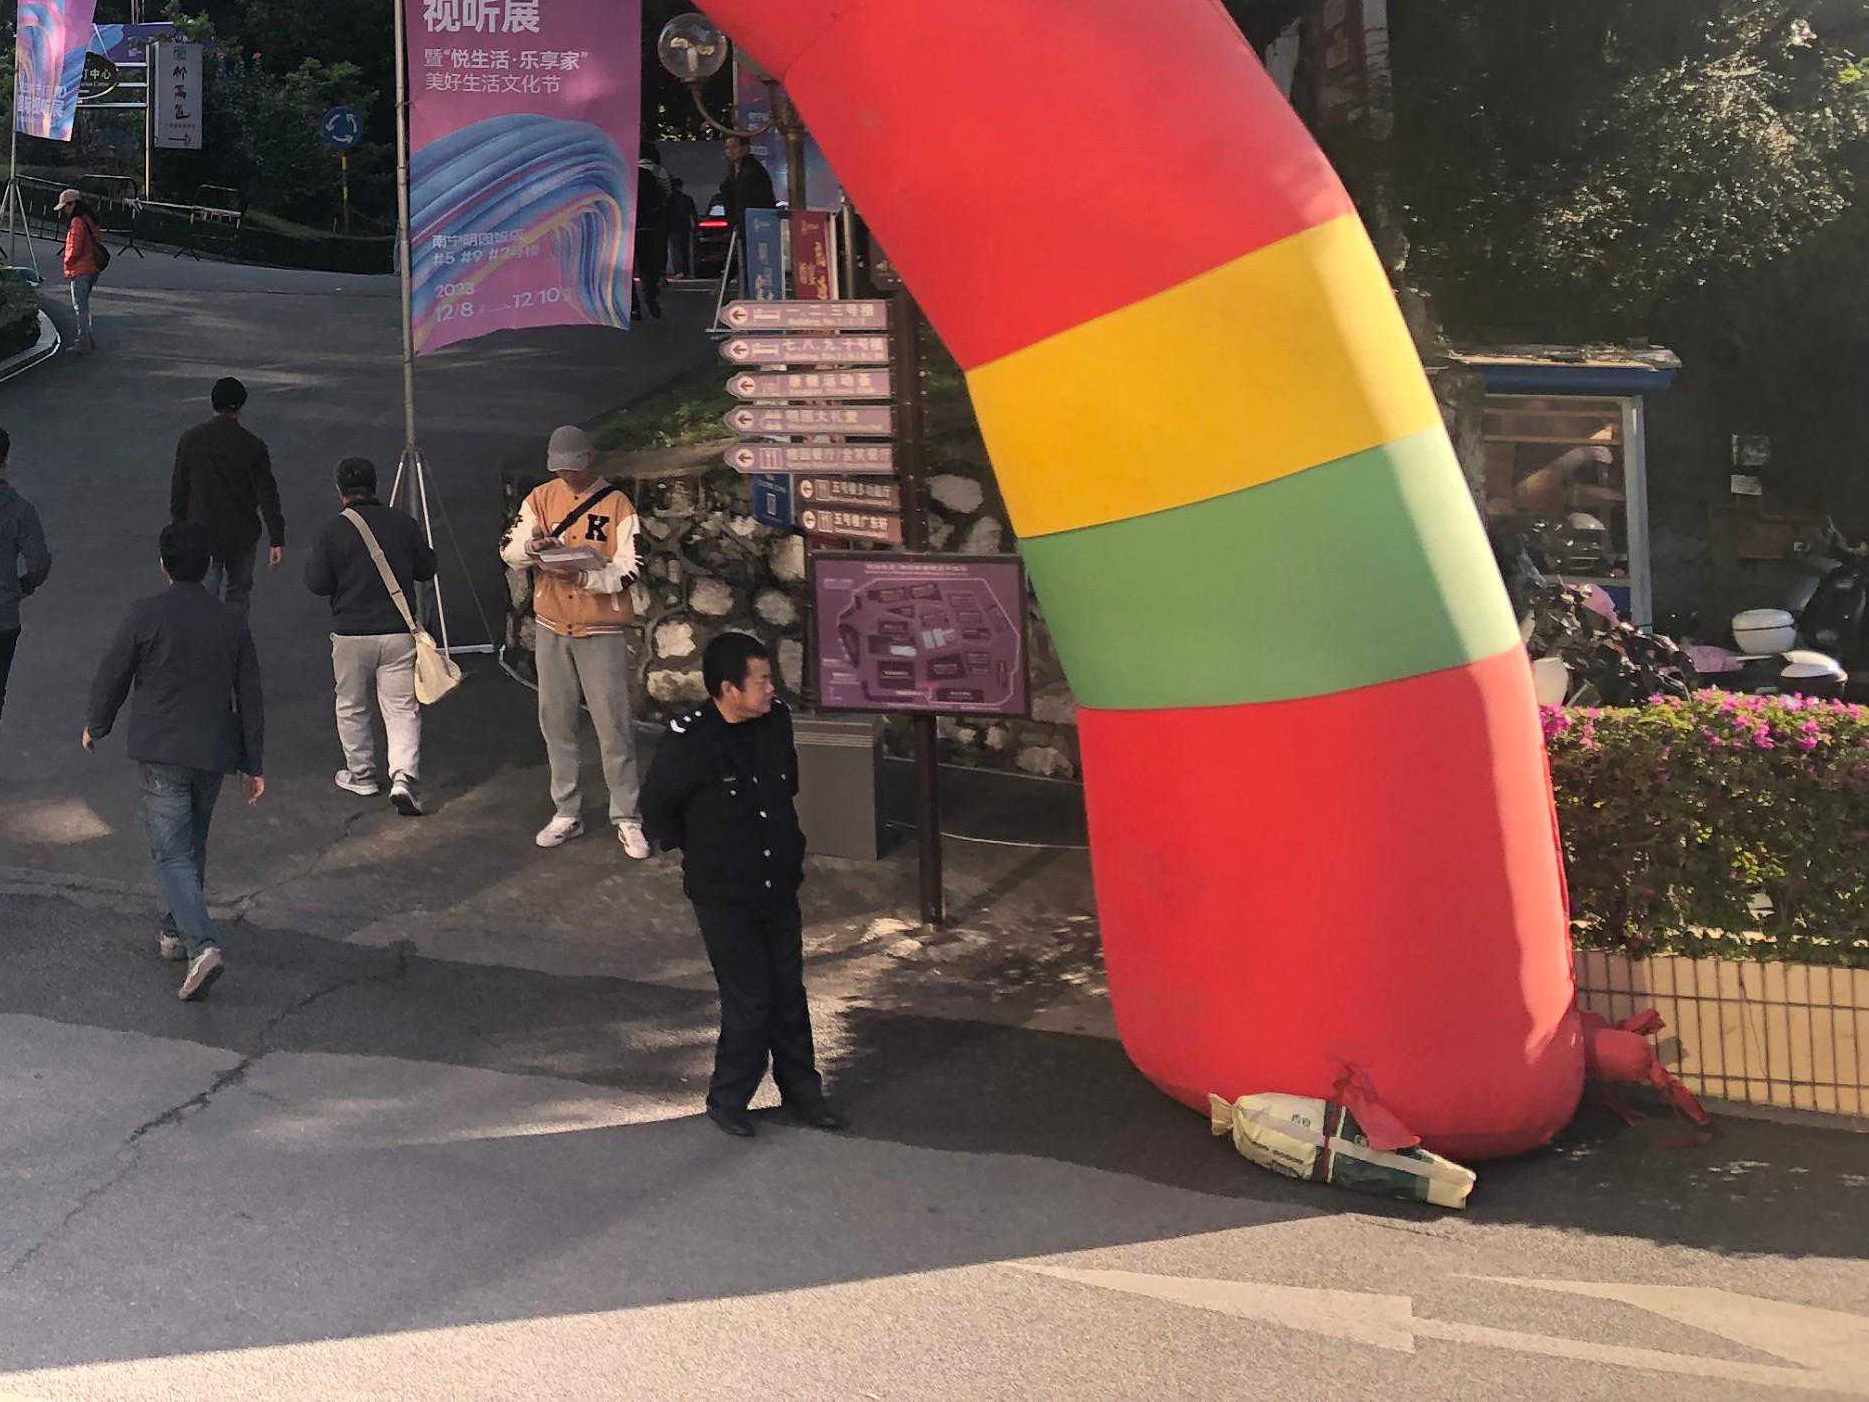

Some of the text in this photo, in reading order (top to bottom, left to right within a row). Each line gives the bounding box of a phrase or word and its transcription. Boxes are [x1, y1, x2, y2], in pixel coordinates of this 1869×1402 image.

[425, 72, 561, 94] 美好生活文化节
[435, 282, 476, 299] 2023
[584, 513, 610, 542] K
